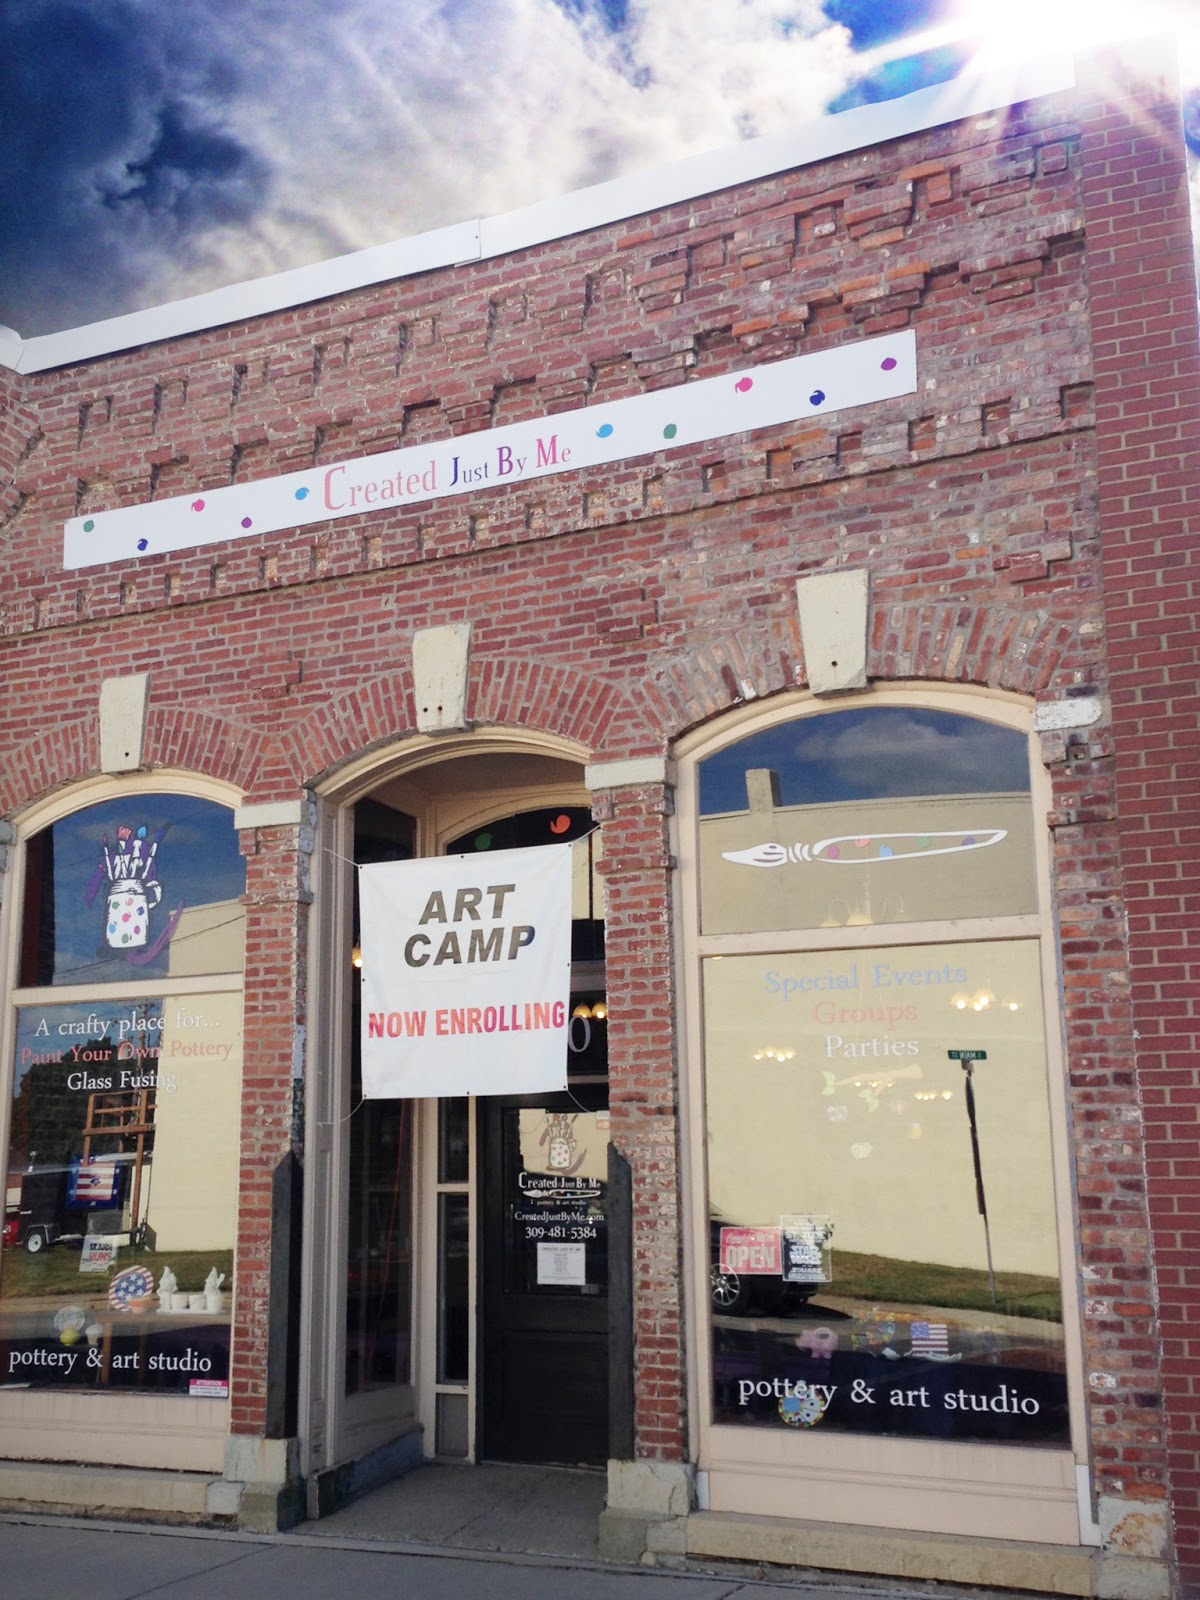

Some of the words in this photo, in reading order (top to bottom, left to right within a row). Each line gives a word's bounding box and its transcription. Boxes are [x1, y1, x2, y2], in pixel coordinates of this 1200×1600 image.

[324, 460, 437, 511] Created
[449, 456, 489, 487] Just
[497, 446, 527, 477] By
[535, 434, 572, 468] Me
[418, 883, 516, 926] ART
[404, 925, 536, 968] CAMP
[764, 964, 858, 1001] Special
[872, 963, 967, 988] Events
[34, 1018, 50, 1037] A
[58, 1013, 111, 1040] crafty
[118, 1011, 167, 1039] place
[176, 1007, 221, 1029] for...
[368, 1010, 427, 1039] NOW
[435, 1000, 565, 1036] ENROLLING
[812, 1001, 919, 1031] Groups
[20, 1048, 63, 1066] Paint
[70, 1046, 112, 1063] Your
[119, 1040, 160, 1061] Own
[170, 1039, 233, 1062] Pottery
[825, 1035, 919, 1059] Parties
[67, 1072, 112, 1091] Glass
[119, 1070, 177, 1093] Fusing
[518, 1172, 558, 1189] Created
[560, 1177, 575, 1188] Just
[576, 1177, 587, 1189] By
[589, 1177, 601, 1188] Me
[514, 1211, 604, 1224] CreatedJustByMe.com
[525, 1226, 597, 1239] 309-481-5384
[726, 1245, 775, 1269] OPEN
[8, 1348, 78, 1374] pottery
[86, 1347, 103, 1368] &
[112, 1353, 140, 1369] art
[148, 1348, 212, 1372] studio
[738, 1376, 838, 1411] pottery
[851, 1379, 876, 1405] &
[890, 1386, 930, 1408] art
[943, 1384, 1040, 1416] studio
